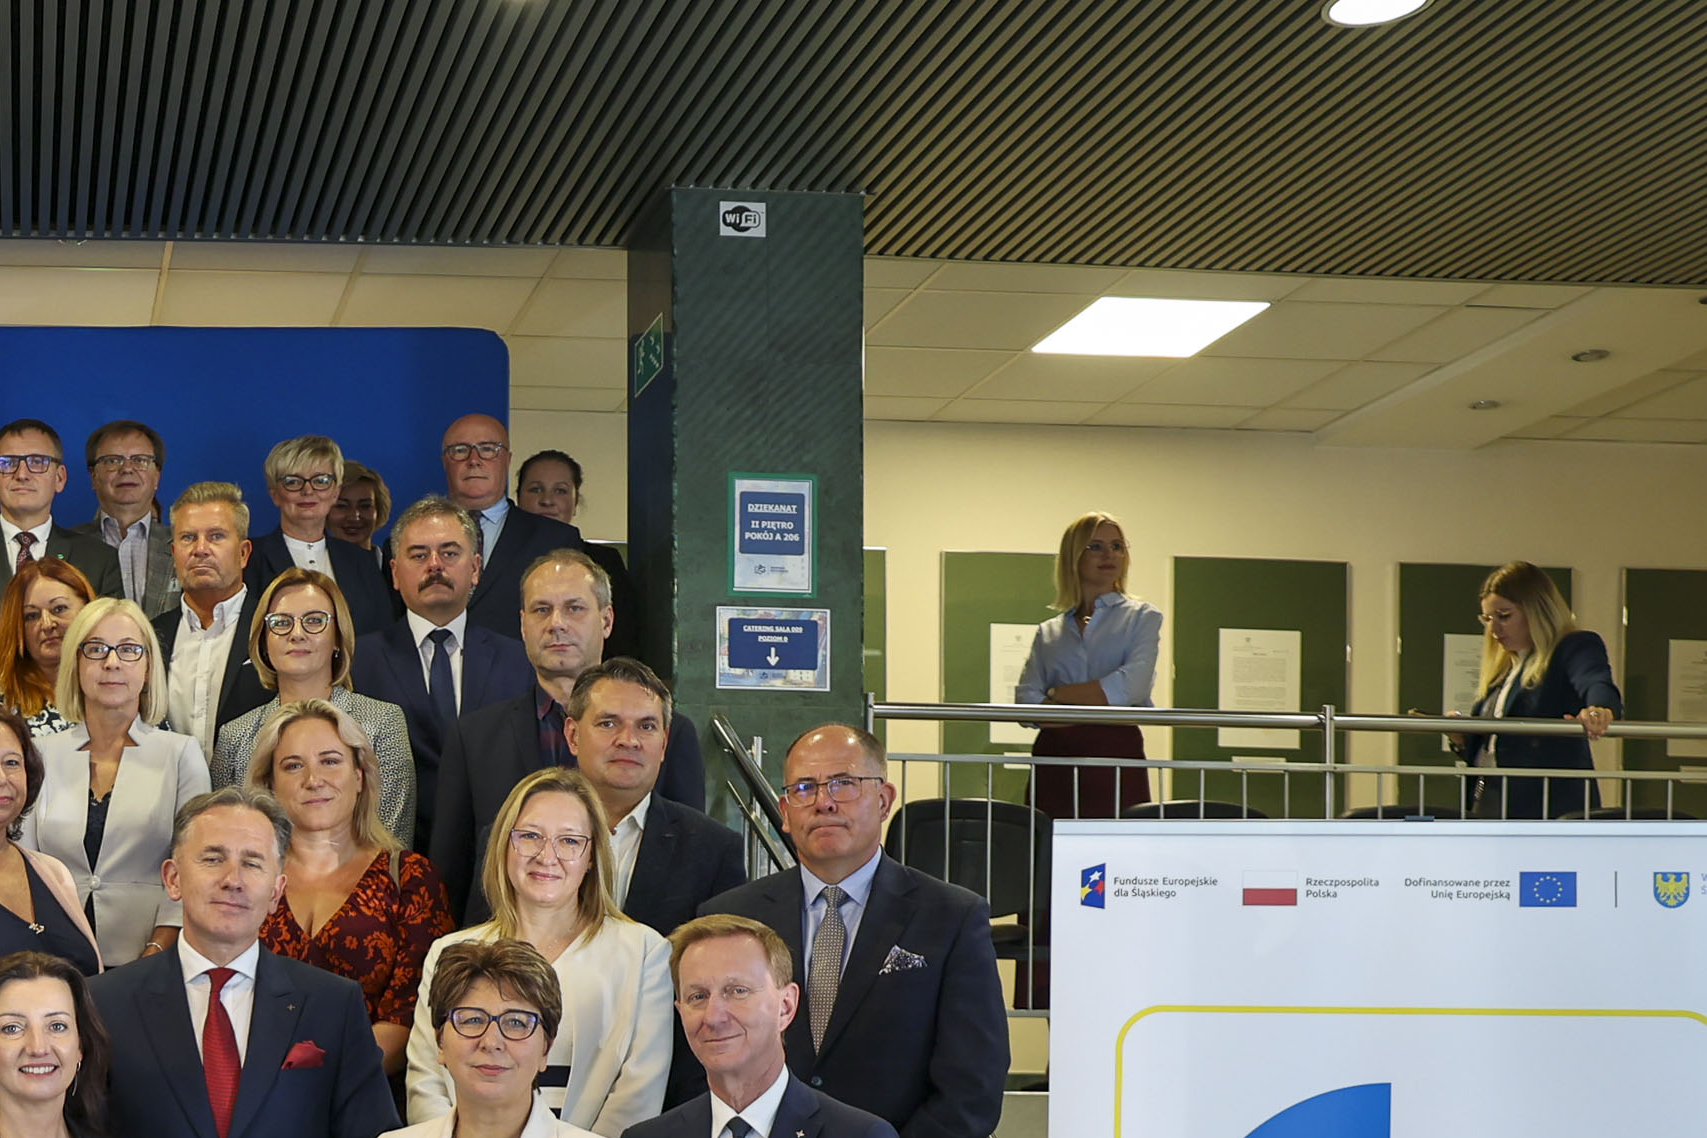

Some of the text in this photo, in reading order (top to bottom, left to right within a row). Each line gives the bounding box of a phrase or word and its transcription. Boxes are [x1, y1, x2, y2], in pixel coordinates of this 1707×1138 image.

[747, 503, 798, 514] DZIEKANAT
[751, 520, 795, 531] II PIĘTRO
[744, 530, 800, 542] POKÓJ A 206
[1113, 875, 1219, 888] Fundusze Europejskie
[1305, 877, 1380, 888] Rzeczpospolita
[1404, 877, 1511, 889] Dofinansowane przez
[1113, 886, 1177, 899] dla Śląskiego
[1305, 889, 1338, 898] Polska
[1431, 889, 1511, 901] Unię Europejską
